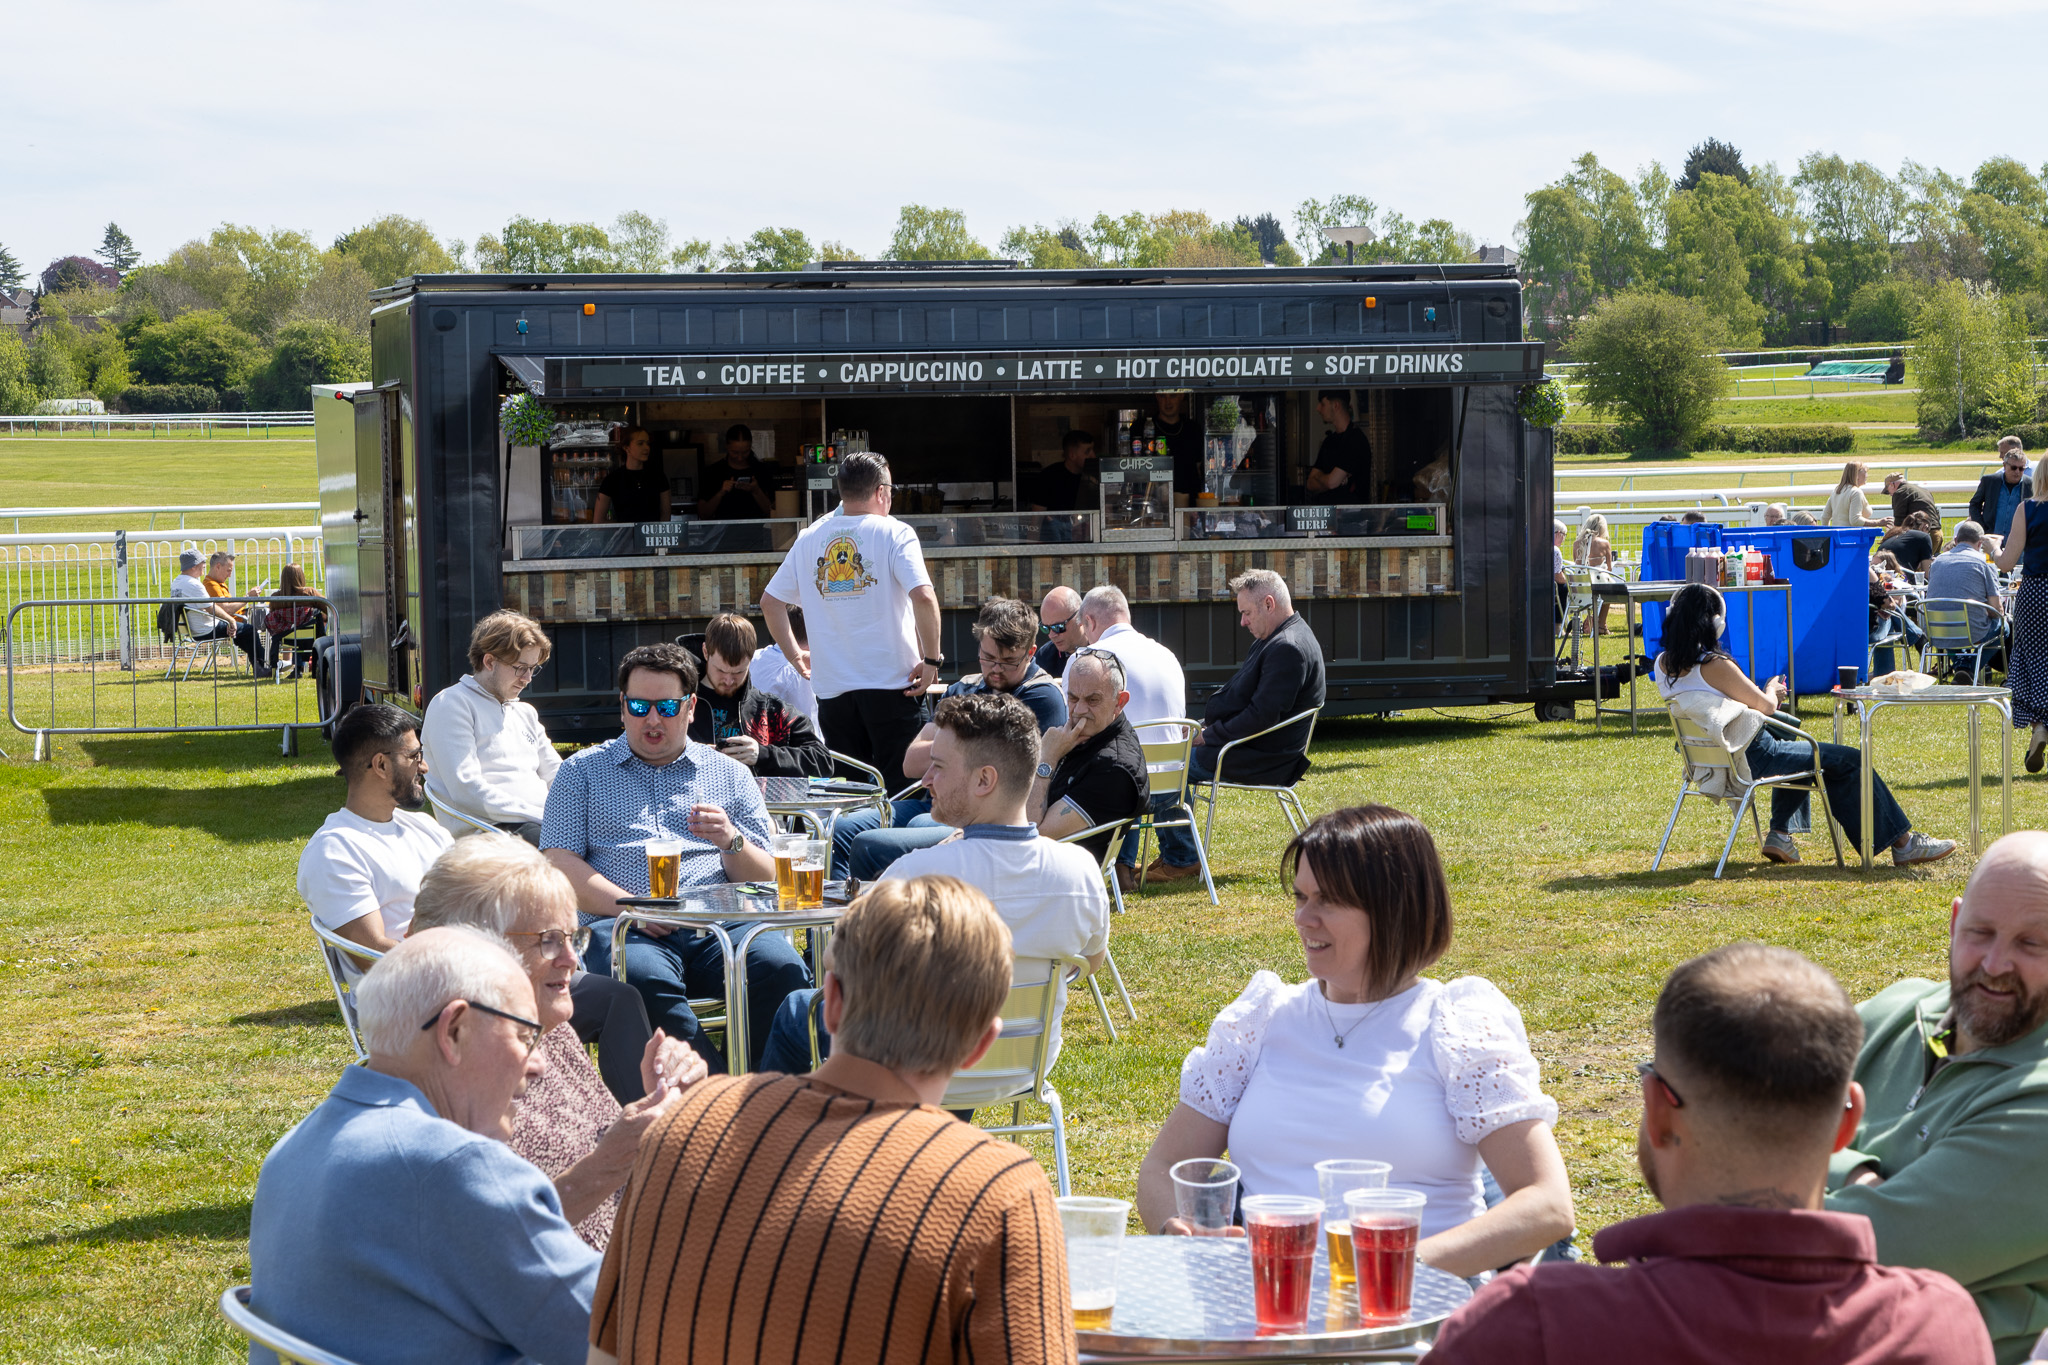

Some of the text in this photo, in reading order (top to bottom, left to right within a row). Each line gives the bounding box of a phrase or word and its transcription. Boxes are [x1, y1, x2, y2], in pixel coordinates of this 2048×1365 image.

[642, 353, 1464, 386] TEA COFFEE CAPPUCCINO LATTE HOT CHOCOLATE SOFT DRINKS
[1119, 458, 1154, 470] CHIPS
[1293, 508, 1331, 518] QUEUE
[641, 523, 682, 534] QUEUE
[1296, 519, 1328, 530] HERE
[645, 536, 679, 547] HERE
[712, 708, 729, 722] OU
